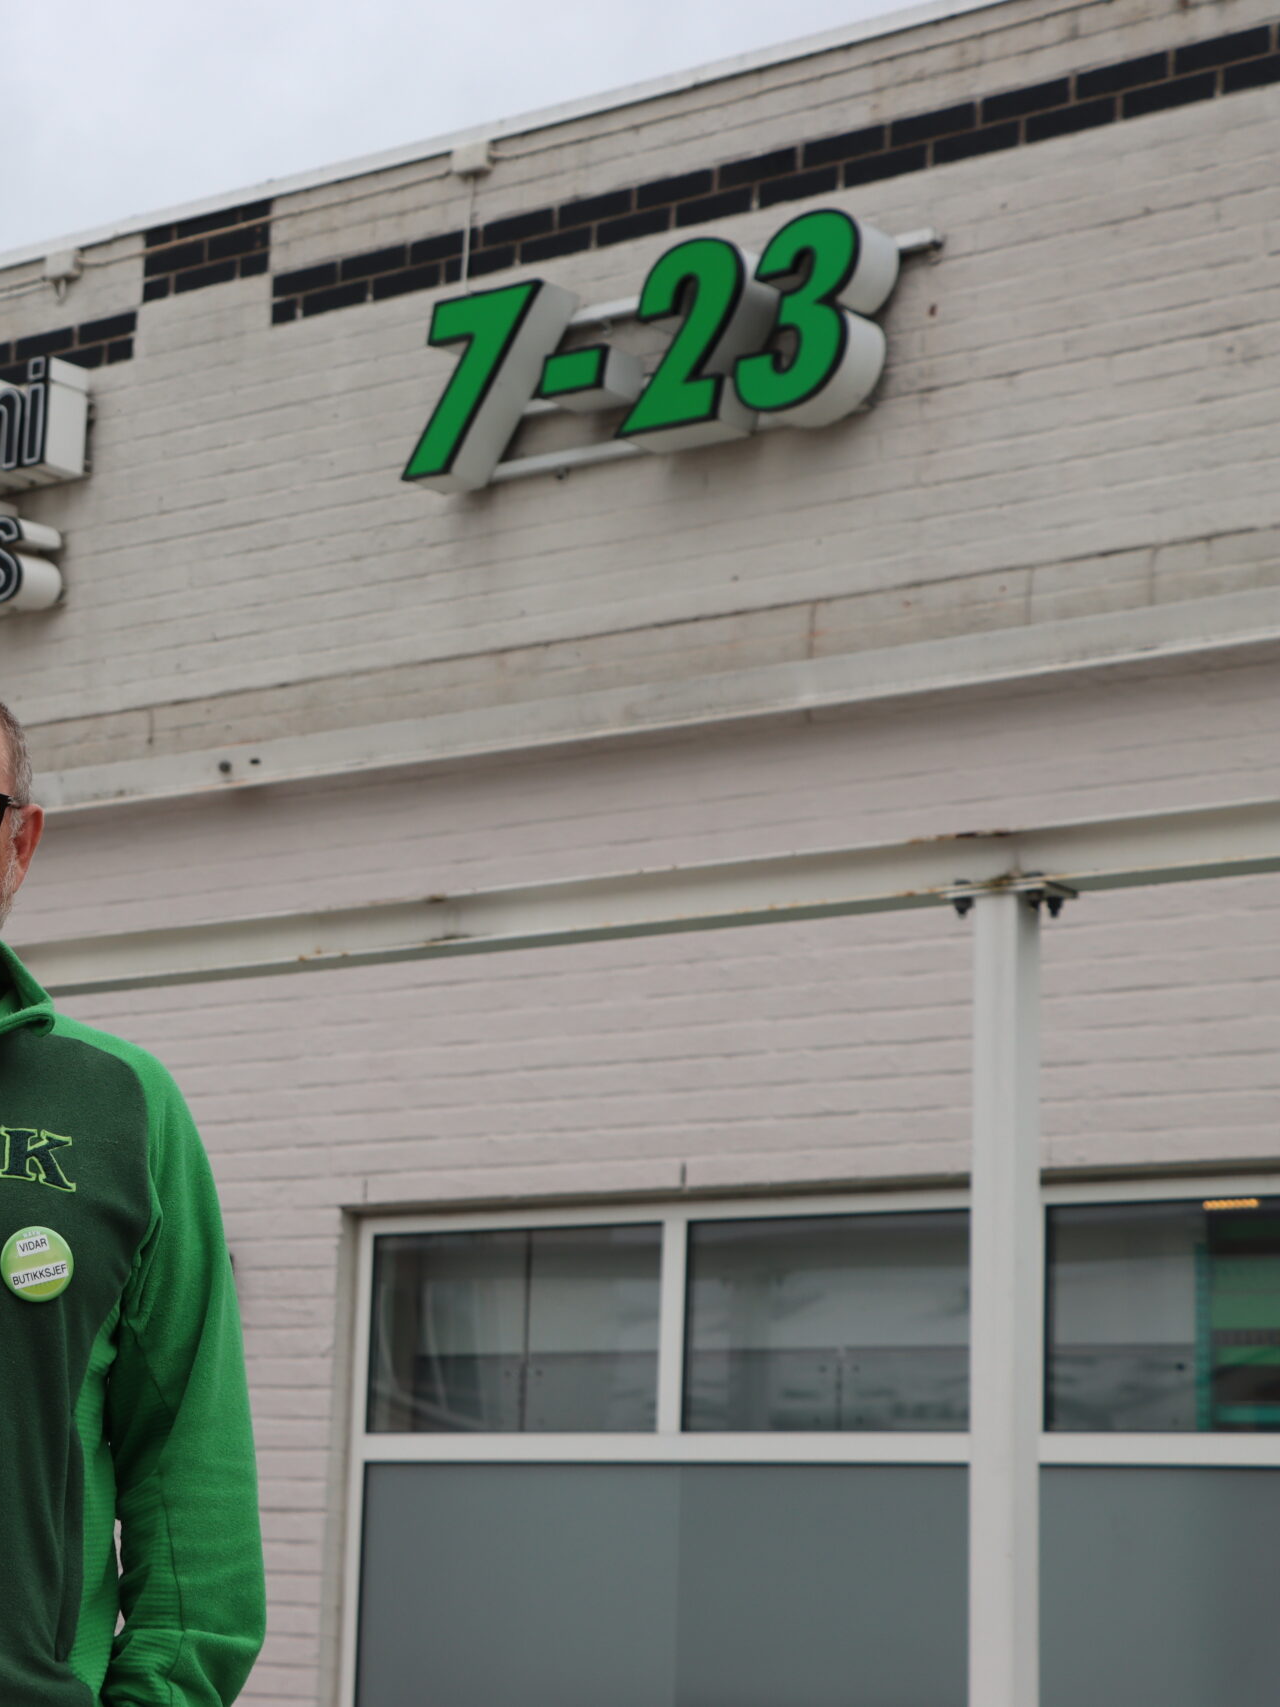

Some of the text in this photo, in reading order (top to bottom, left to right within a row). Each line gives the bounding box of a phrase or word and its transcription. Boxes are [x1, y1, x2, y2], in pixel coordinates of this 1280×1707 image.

[402, 208, 860, 481] 7-23
[19, 1237, 48, 1253] VIDAR
[12, 1263, 67, 1286] BUTIKKSJEF
